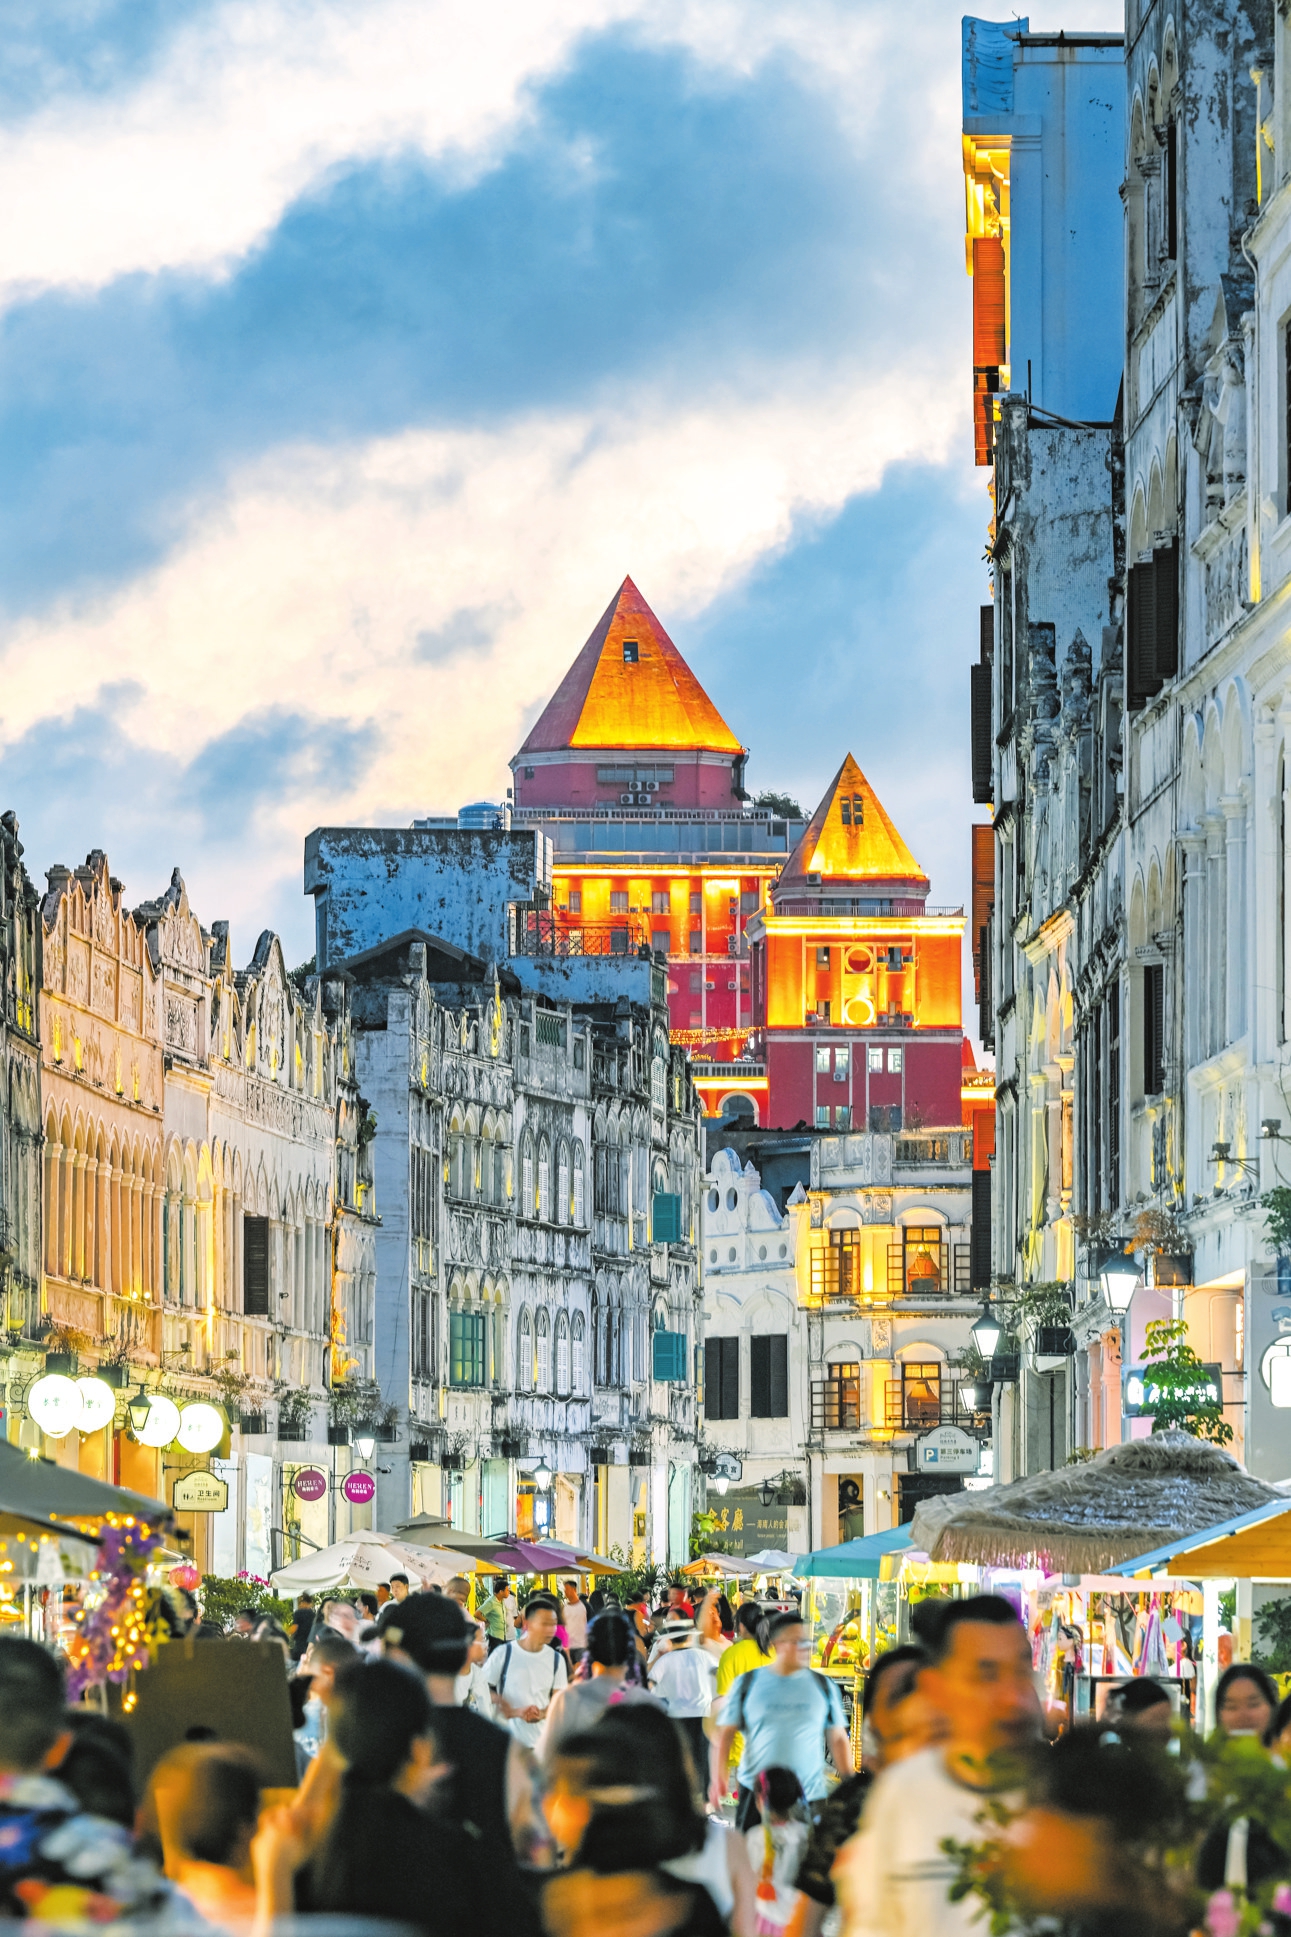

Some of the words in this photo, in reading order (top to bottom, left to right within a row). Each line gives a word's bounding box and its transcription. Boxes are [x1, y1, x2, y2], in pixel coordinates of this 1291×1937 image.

[297, 1479, 323, 1488] HEREN
[347, 1482, 373, 1490] HEREN
[197, 1489, 220, 1498] 卫生间
